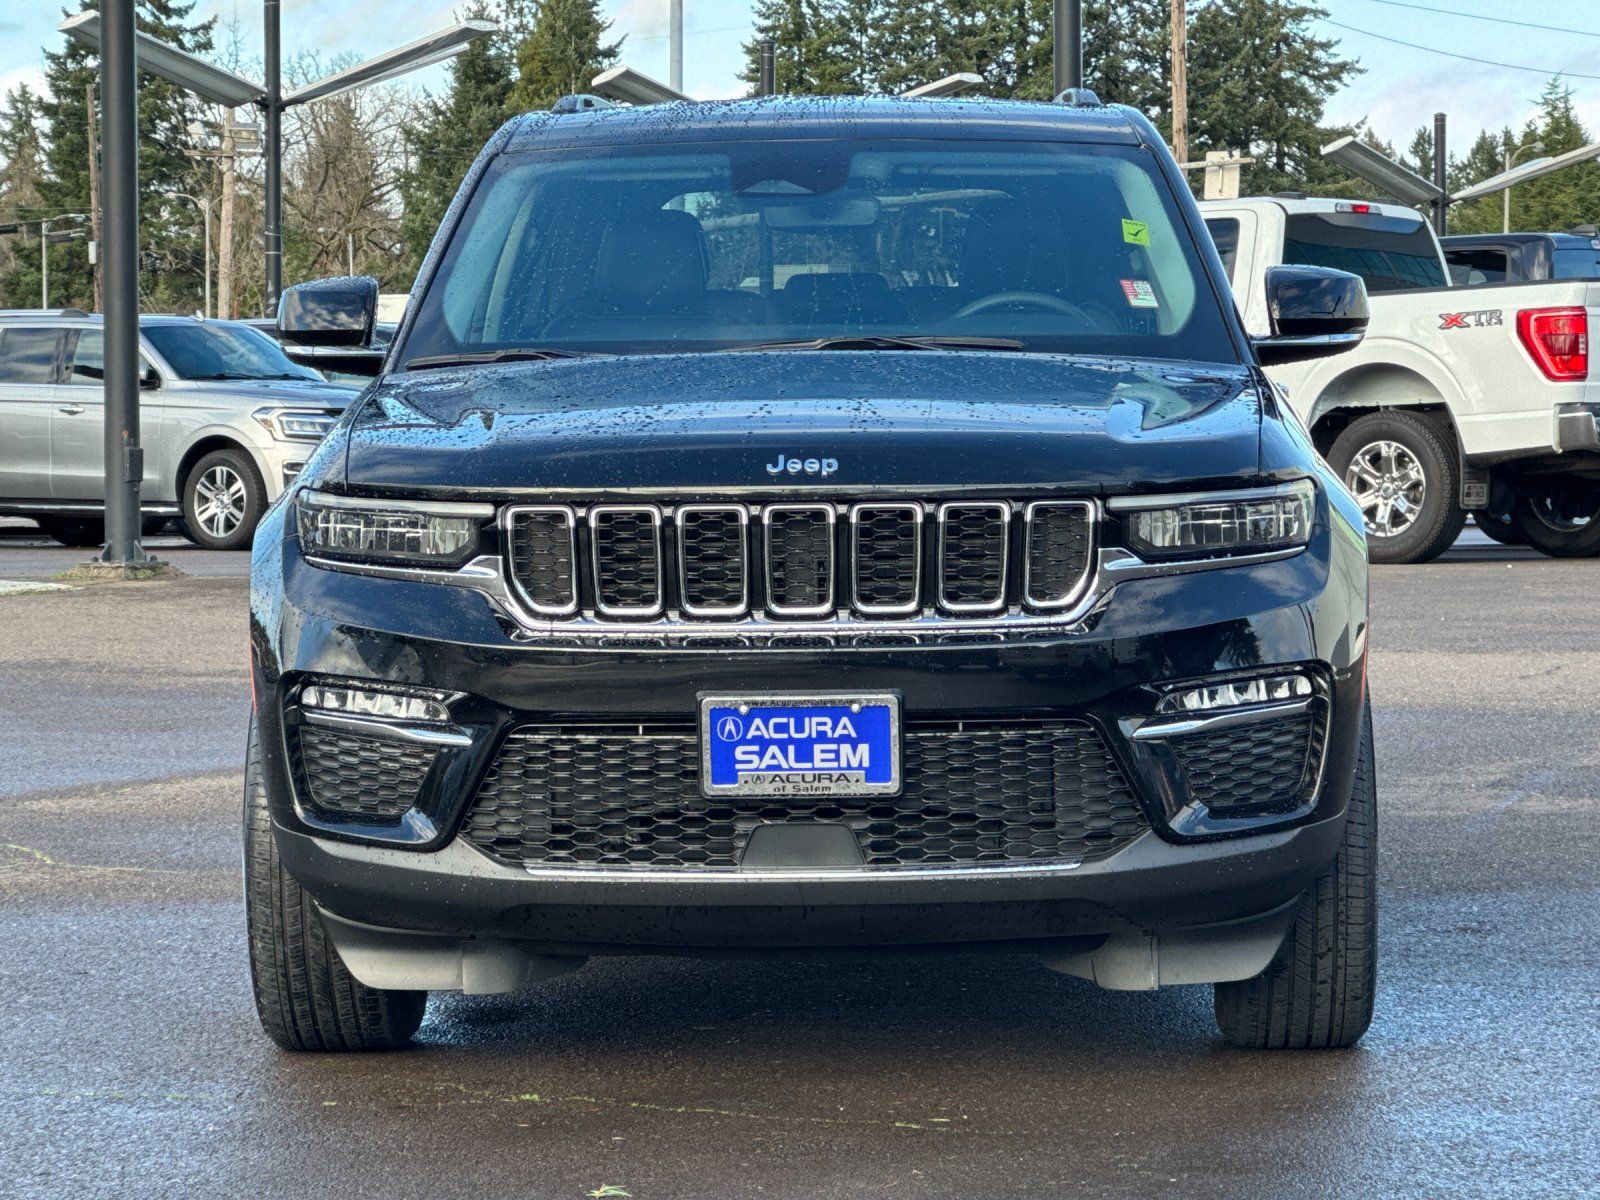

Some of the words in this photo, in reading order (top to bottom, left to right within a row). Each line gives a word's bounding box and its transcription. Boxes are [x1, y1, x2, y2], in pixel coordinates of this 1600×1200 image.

[1438, 309, 1503, 330] XTR
[766, 454, 839, 478] Jeep
[746, 716, 858, 739] ACURA
[734, 743, 870, 770] SALEM
[769, 773, 851, 785] ACURA
[773, 785, 786, 793] of
[792, 784, 832, 793] Salem
